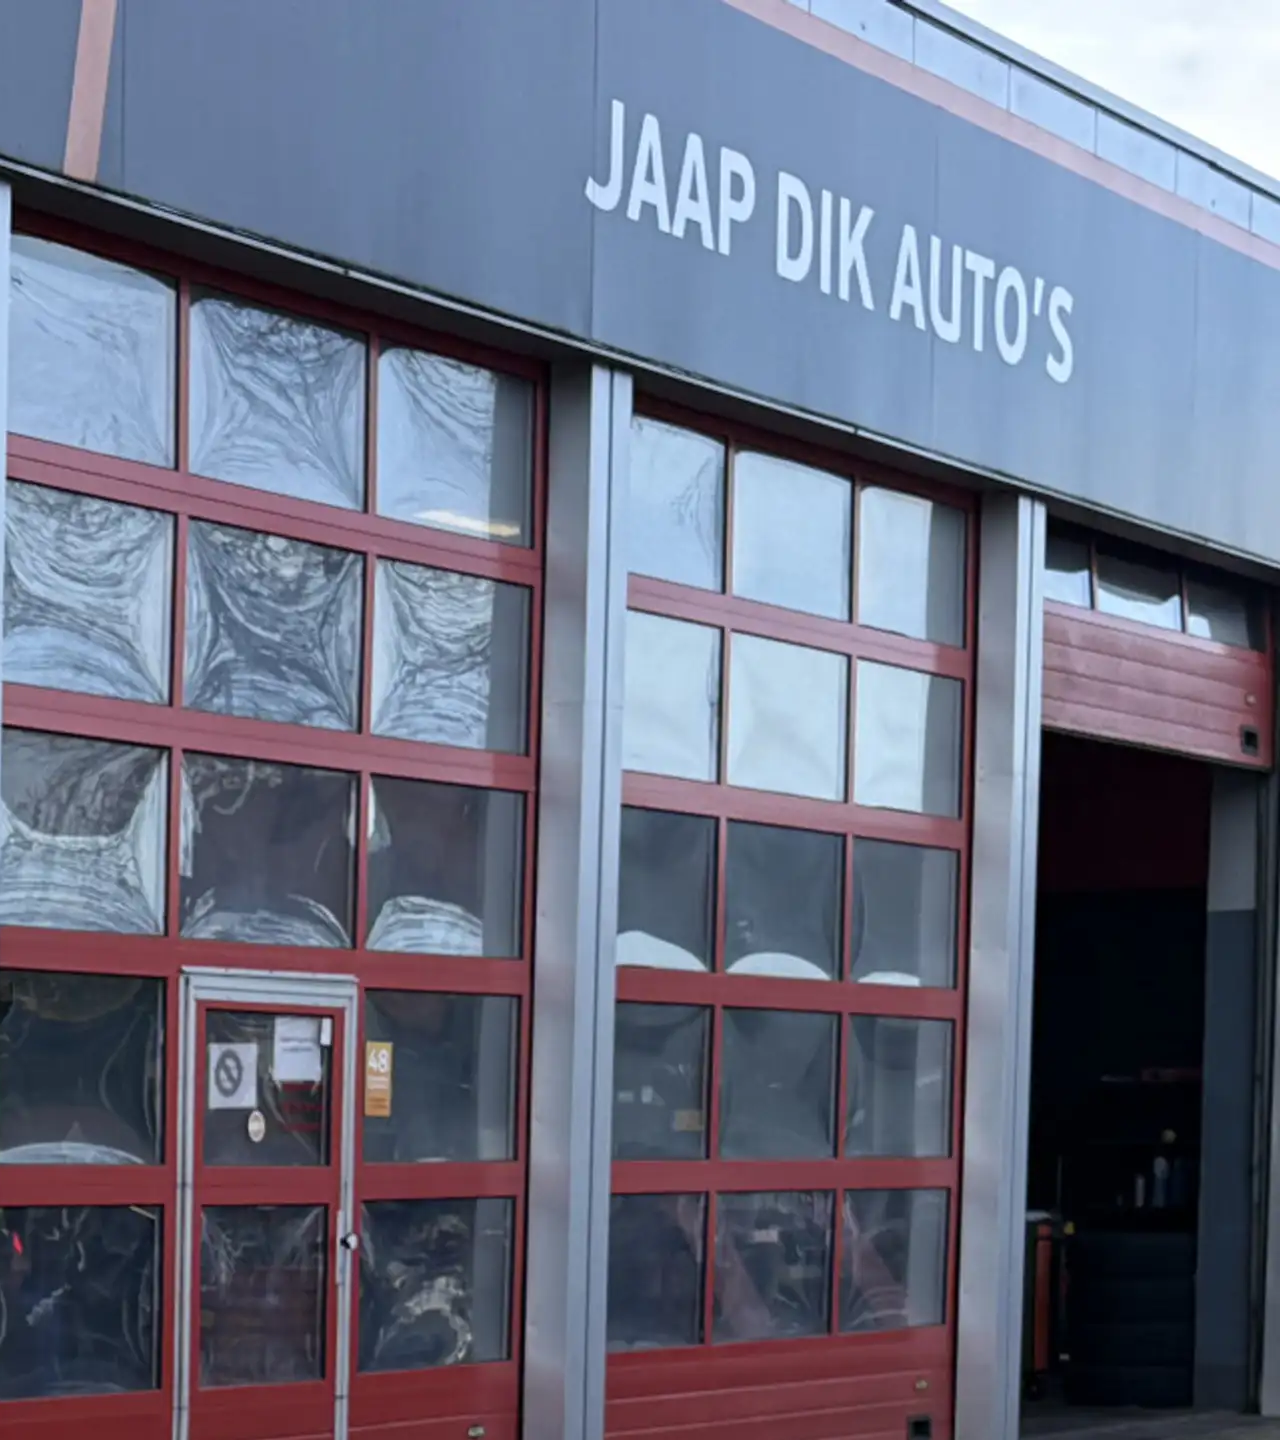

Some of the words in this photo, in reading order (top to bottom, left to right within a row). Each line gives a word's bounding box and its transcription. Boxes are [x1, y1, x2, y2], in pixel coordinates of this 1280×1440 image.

[584, 98, 756, 256] JAAP
[776, 170, 875, 312] DIK
[889, 224, 1075, 384] AUTO'S
[368, 1048, 389, 1074] 48
